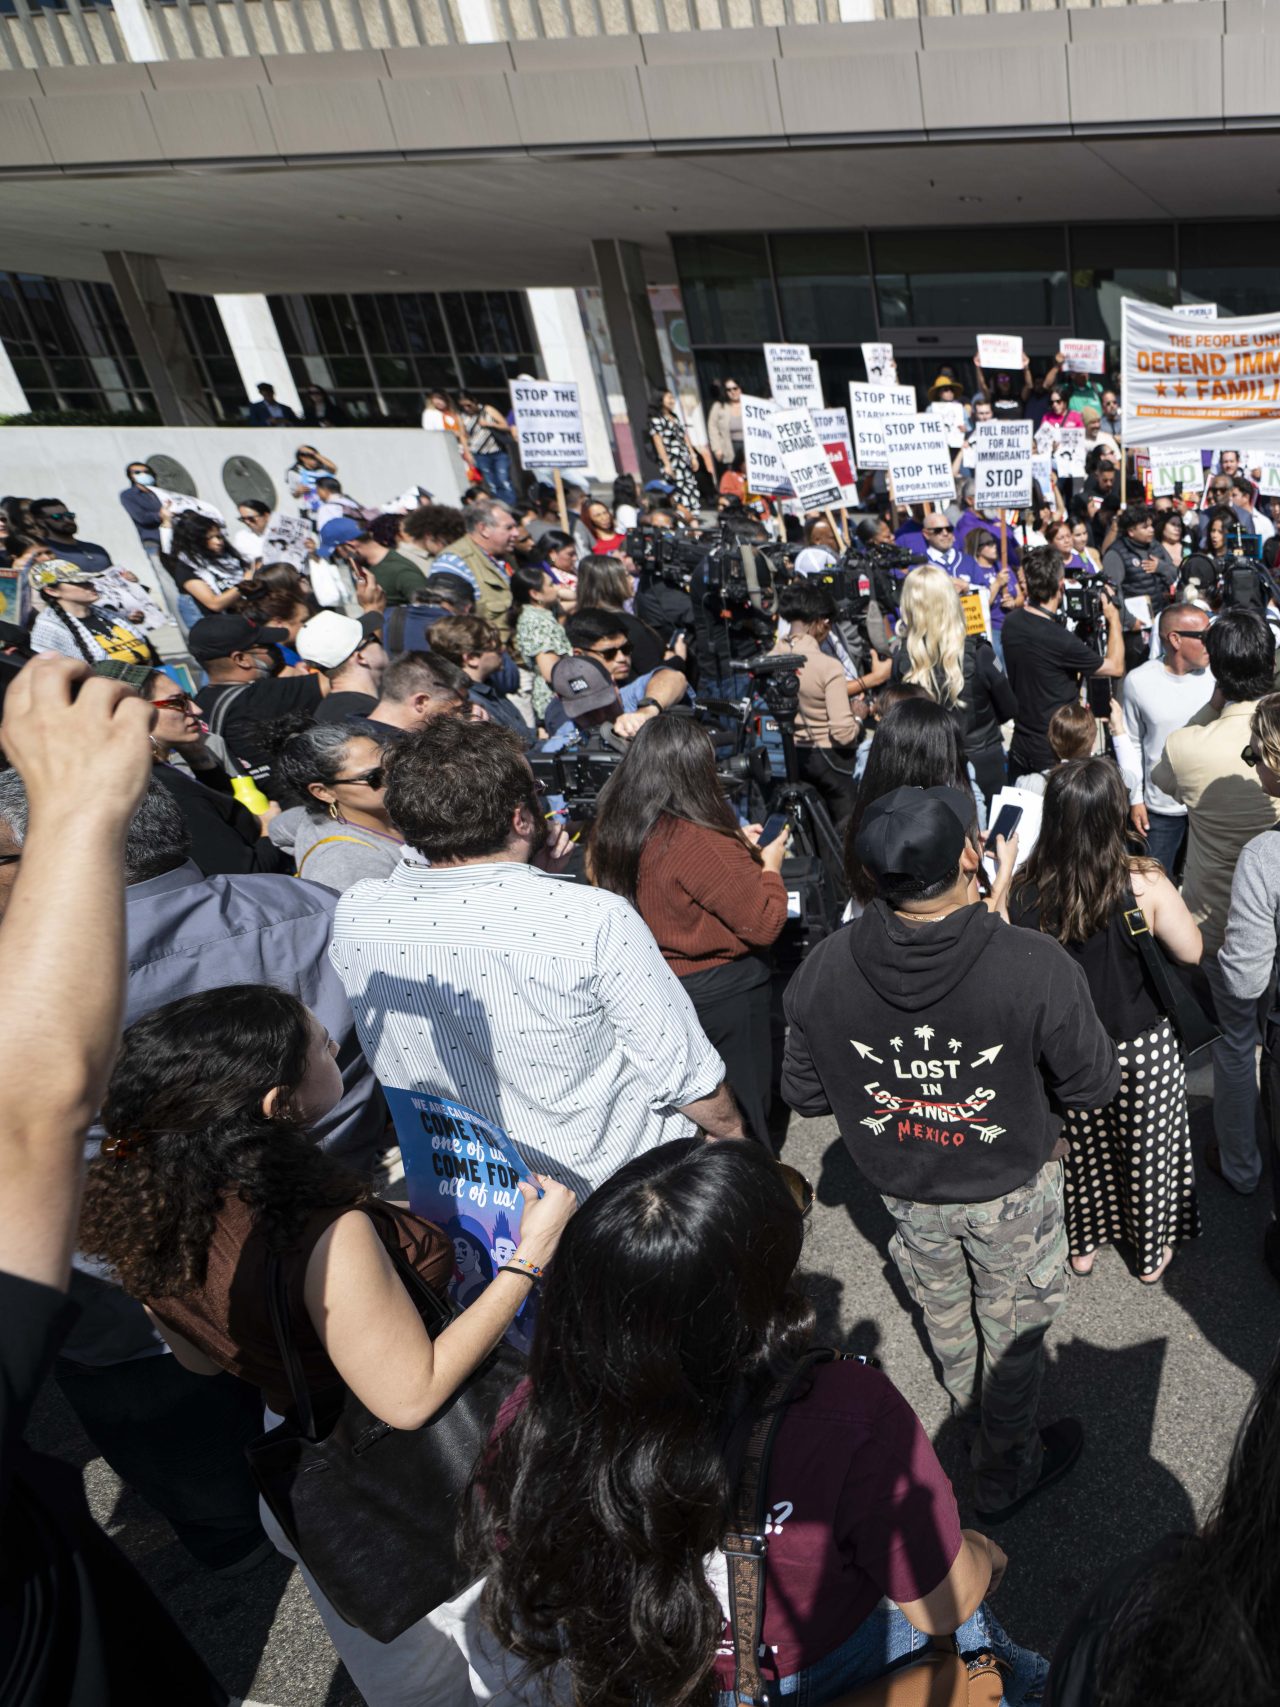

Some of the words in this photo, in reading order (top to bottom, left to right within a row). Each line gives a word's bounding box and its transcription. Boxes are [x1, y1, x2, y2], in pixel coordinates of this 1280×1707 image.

[1168, 334, 1193, 348] THE
[1195, 334, 1249, 348] PEOPLE
[1136, 350, 1227, 376] DEFEND
[776, 374, 793, 383] ARE
[796, 373, 813, 383] THE
[515, 388, 549, 401] STOP
[553, 390, 578, 402] THE
[788, 396, 808, 407] NOT
[854, 391, 886, 404] STOP
[890, 394, 913, 406] THE
[776, 419, 813, 439] PEOPLE
[884, 422, 916, 436] STOP
[919, 421, 943, 433] THE
[979, 426, 999, 437] FULL
[1000, 424, 1030, 436] RIGHTS
[521, 431, 556, 444] STOP
[559, 432, 583, 444] THE
[988, 438, 1004, 450] FOR
[1006, 437, 1021, 449] ALL
[888, 440, 944, 454] STARVATION!
[748, 452, 778, 467] STOP
[977, 450, 1031, 462] IMMIGRANTS
[789, 467, 814, 485] STOP
[812, 461, 830, 476] THE
[892, 465, 924, 480] STOP
[927, 463, 950, 476] THE
[985, 468, 1024, 488] STOP
[1158, 463, 1197, 486] NO
[895, 480, 952, 493] DEPORATIONS!
[893, 1058, 962, 1080] LOST
[920, 1083, 943, 1097] IN
[410, 1097, 429, 1112] WE
[429, 1101, 448, 1116] ARE
[864, 1081, 904, 1111] LOS
[908, 1086, 997, 1123] ANGELES
[419, 1111, 471, 1142] COME
[898, 1118, 965, 1147] MEXICO
[431, 1135, 463, 1154] one
[466, 1139, 485, 1162] of
[432, 1152, 482, 1184] COME
[486, 1161, 520, 1190] FOR
[438, 1177, 466, 1198] all
[469, 1182, 489, 1208] of
[493, 1187, 521, 1211] us!
